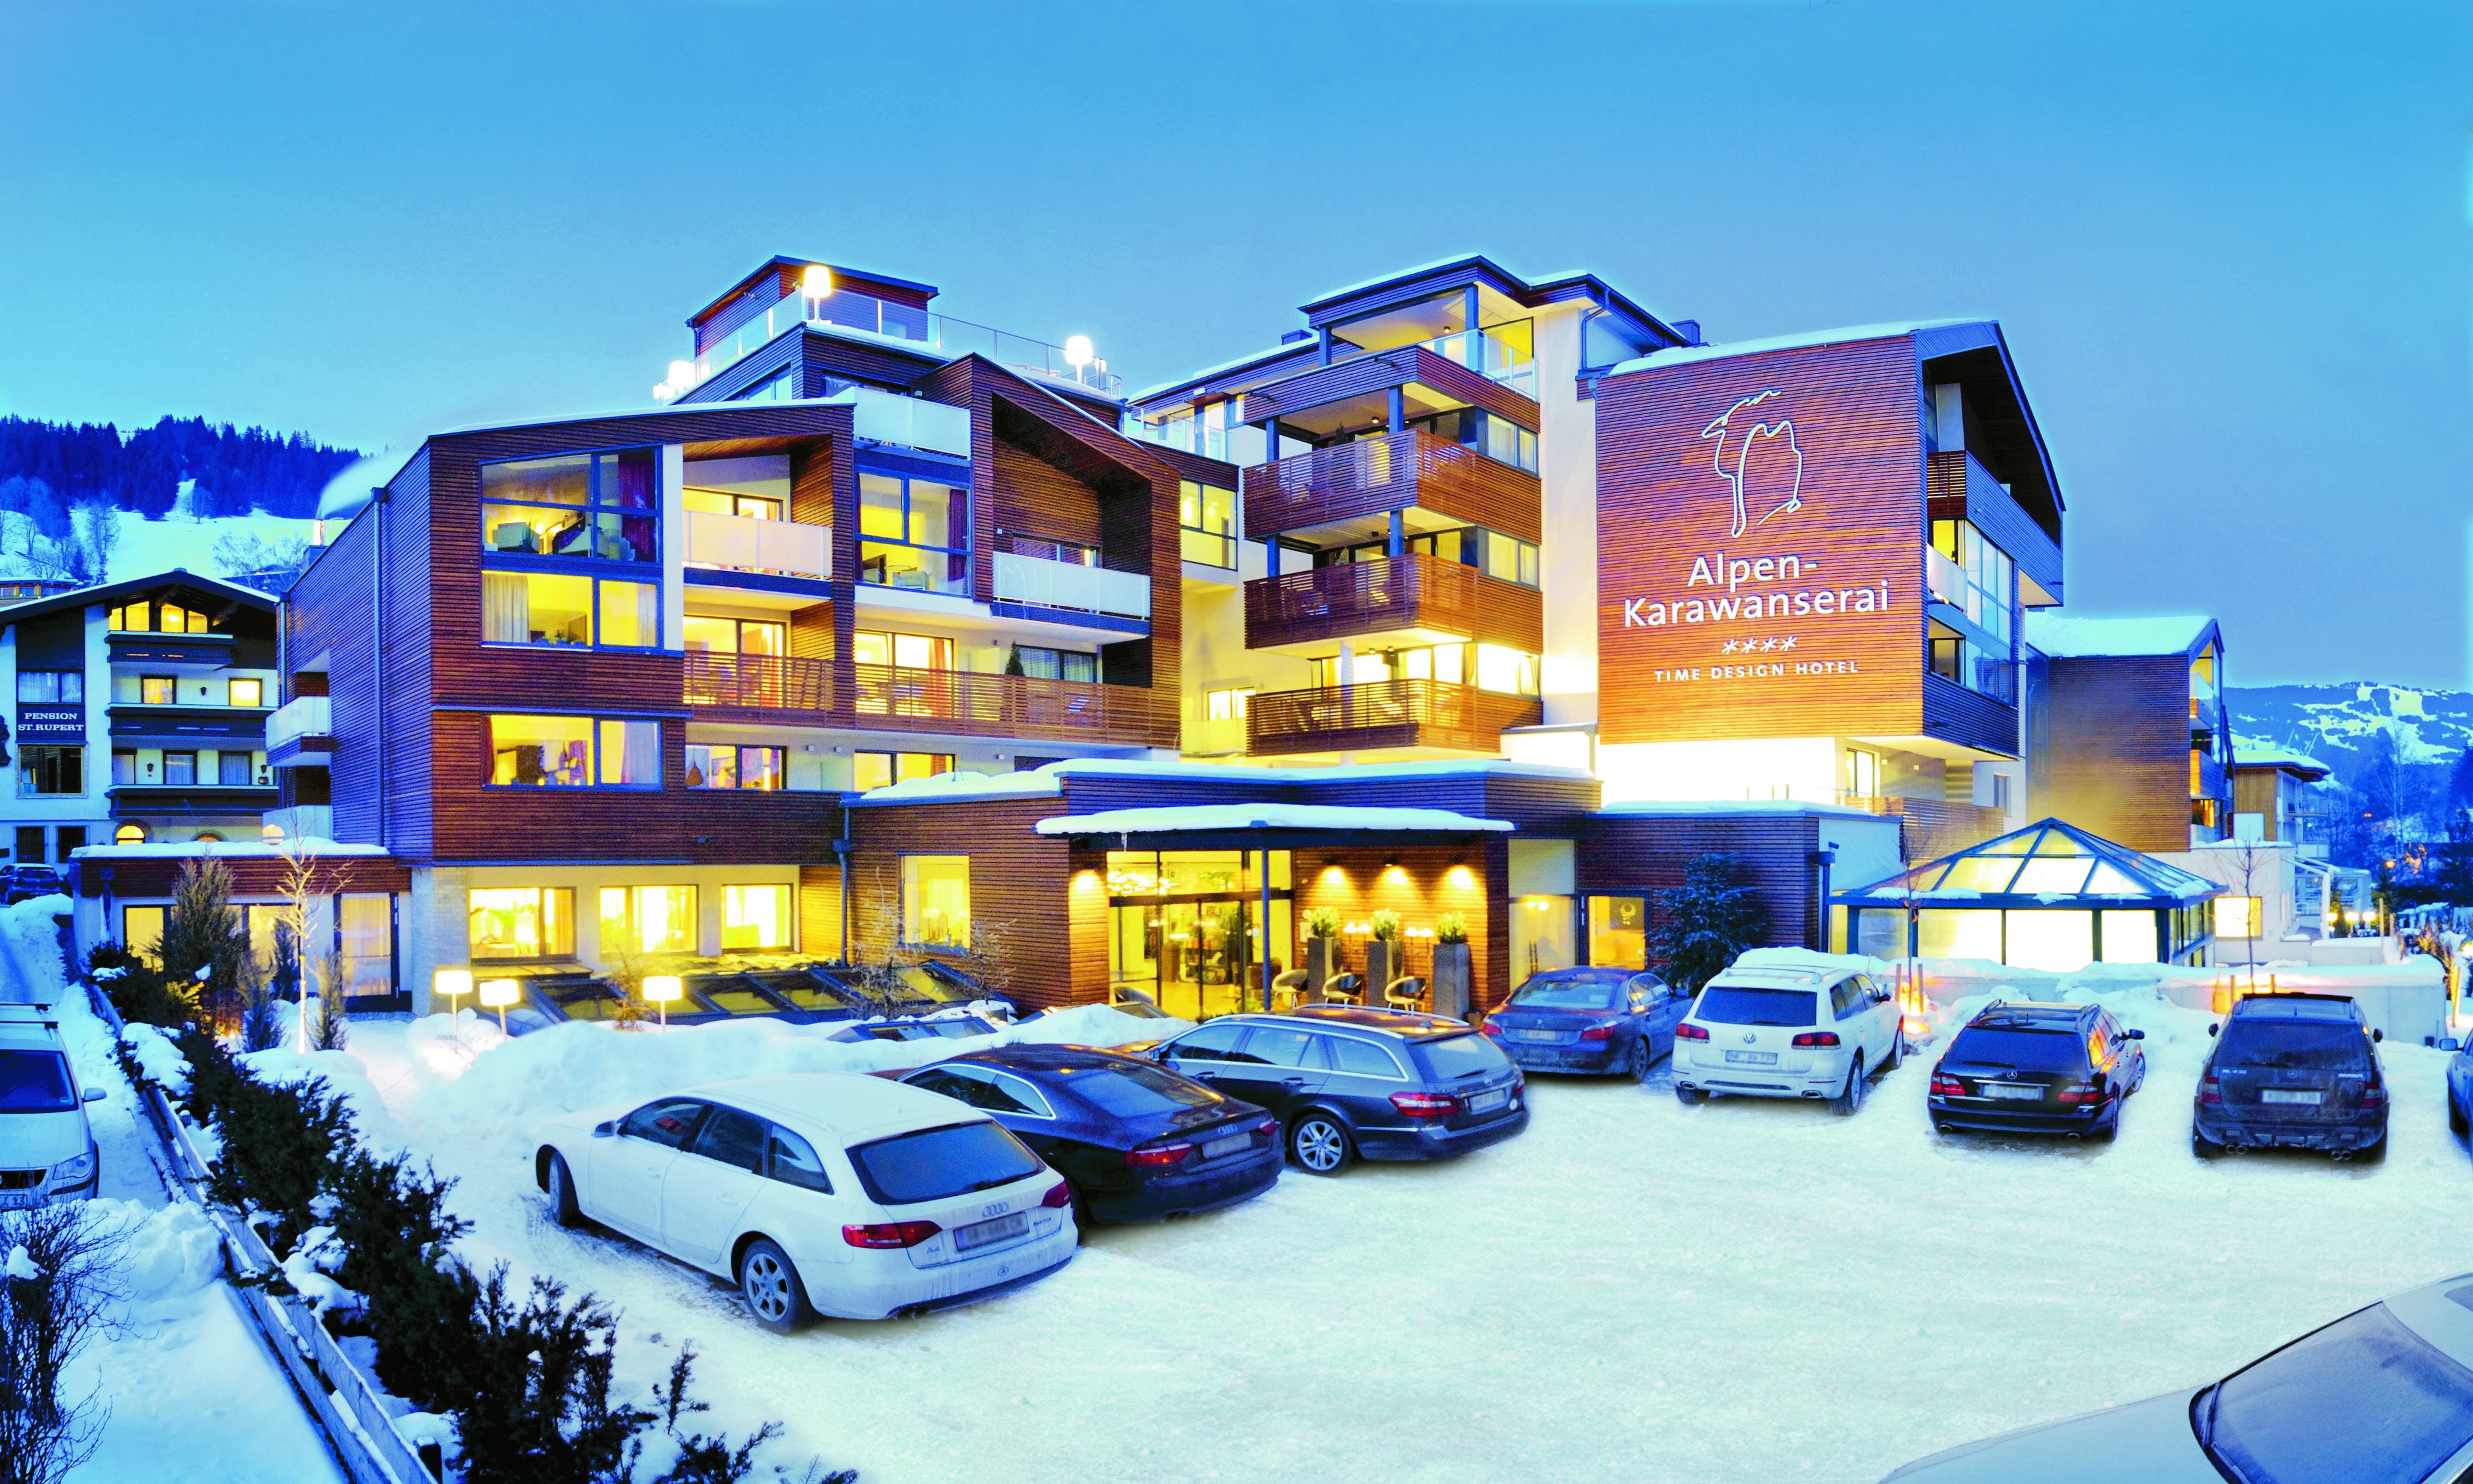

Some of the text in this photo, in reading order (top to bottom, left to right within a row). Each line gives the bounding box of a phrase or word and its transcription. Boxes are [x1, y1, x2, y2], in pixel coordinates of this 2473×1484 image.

[1687, 553, 1818, 593] Alpen-
[1624, 578, 1889, 628] Karawanserai
[1654, 660, 1859, 683] TIME DESIGN HOTEL
